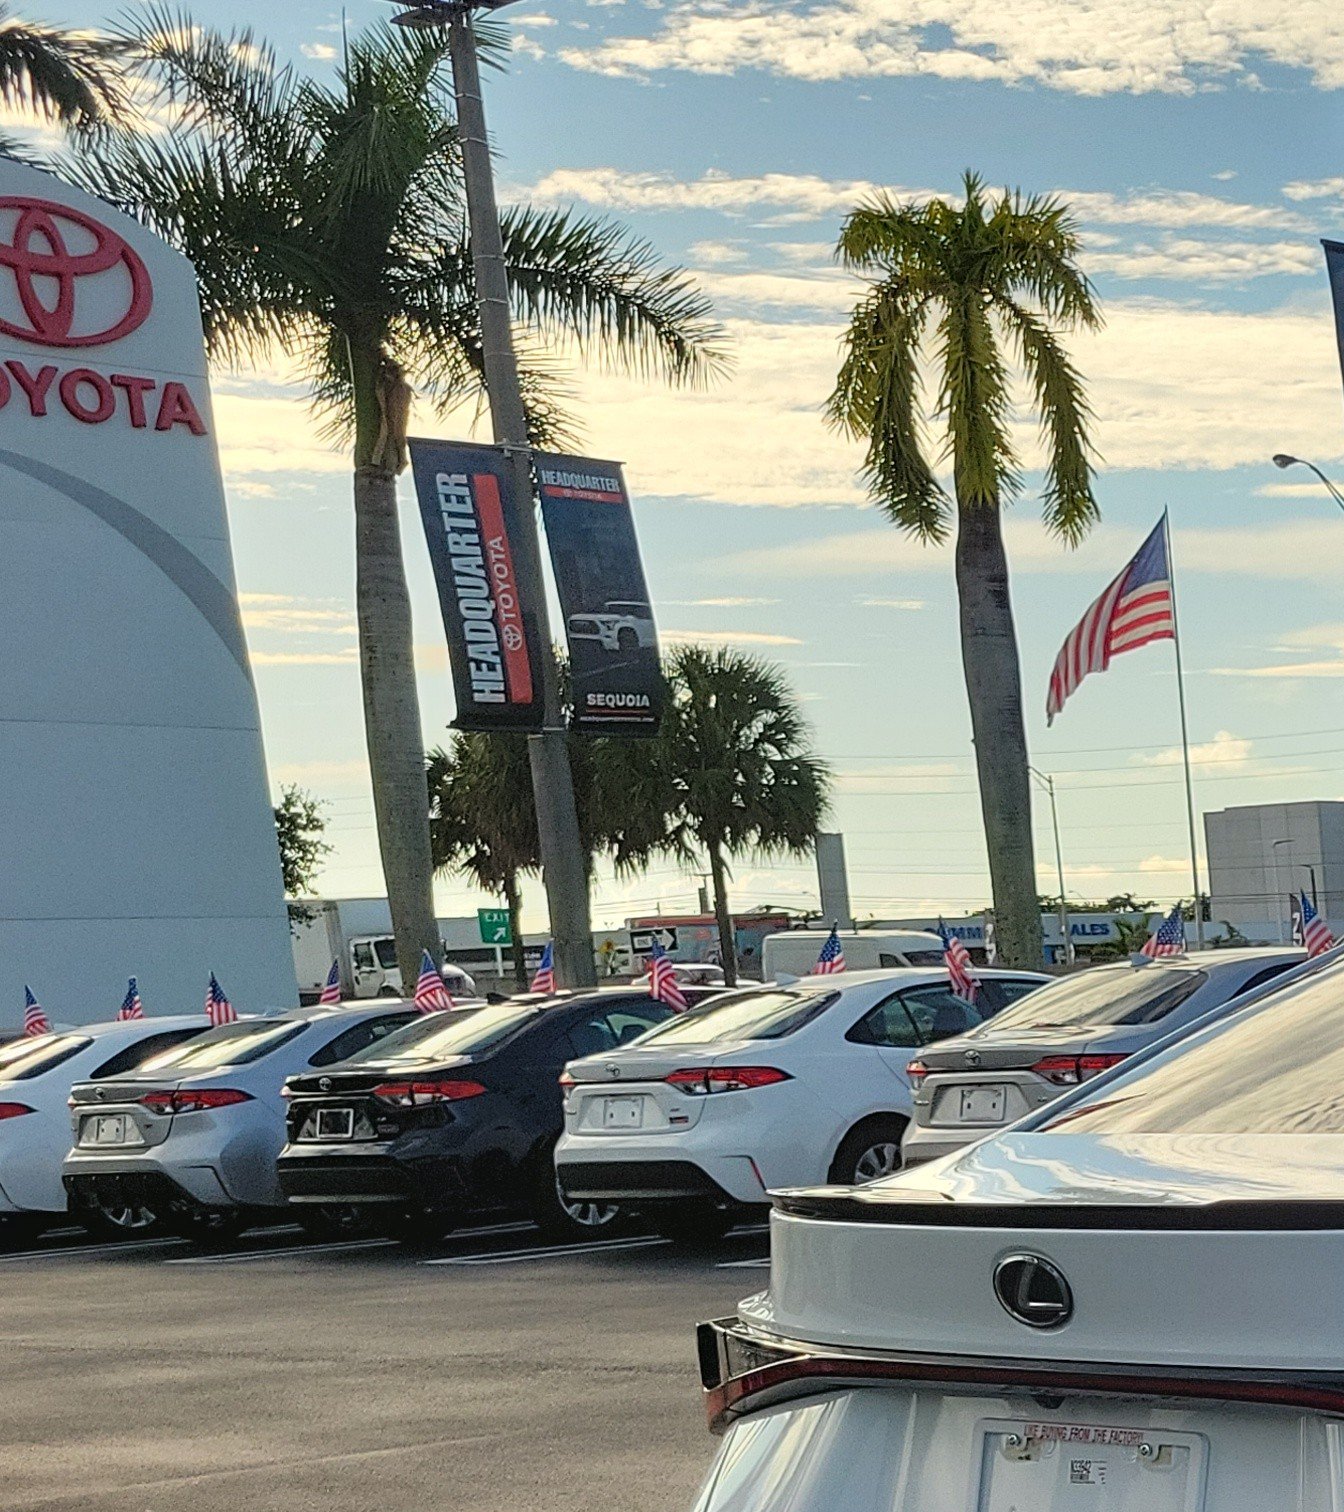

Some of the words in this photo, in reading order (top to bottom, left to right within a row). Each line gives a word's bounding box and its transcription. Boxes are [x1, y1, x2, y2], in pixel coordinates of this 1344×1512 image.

[0, 359, 208, 436] YOTA
[541, 470, 620, 493] HEADQUARTER
[436, 472, 506, 703] HEADQUARTER
[490, 535, 517, 622] TOYOTA
[587, 693, 650, 708] SEQUOIA
[1060, 923, 1110, 936] ALES
[1068, 1427, 1091, 1441] FROM
[1092, 1429, 1107, 1443] THE
